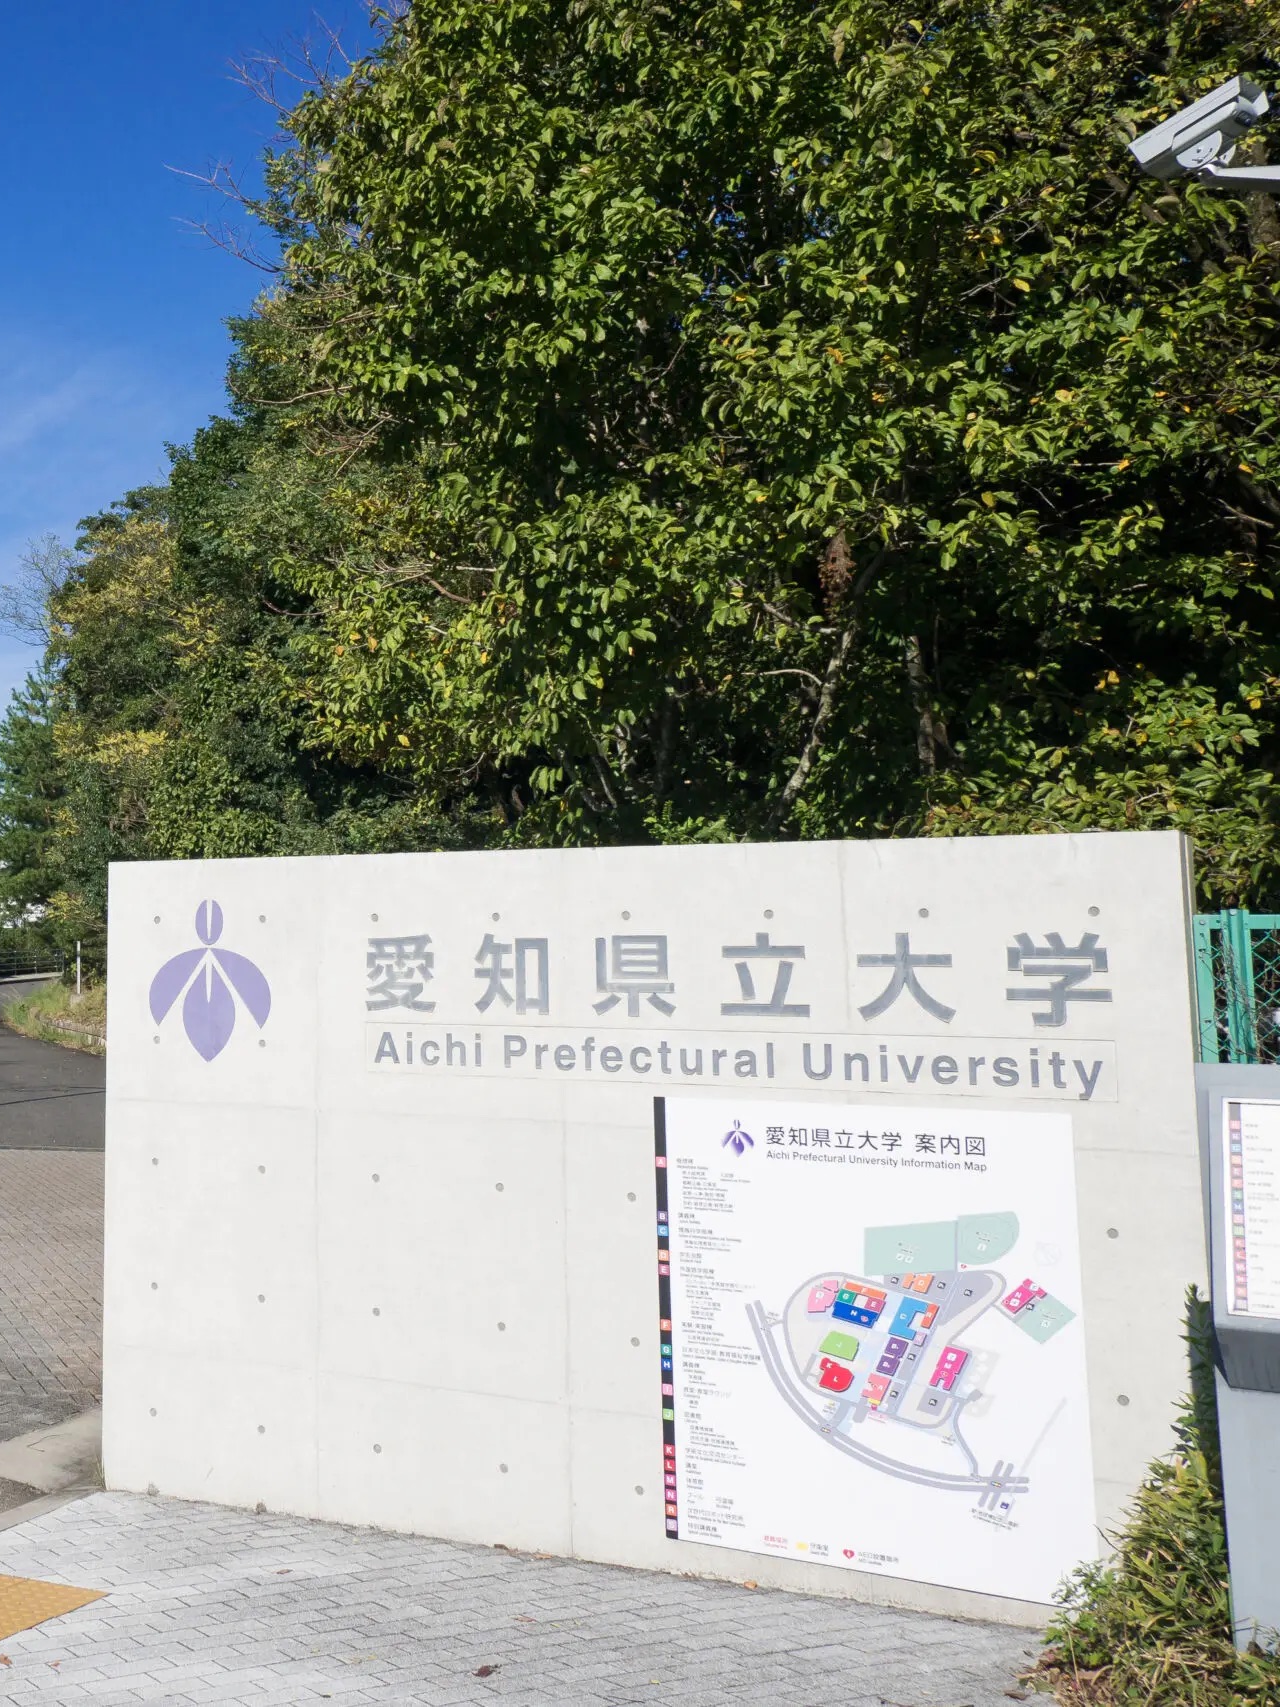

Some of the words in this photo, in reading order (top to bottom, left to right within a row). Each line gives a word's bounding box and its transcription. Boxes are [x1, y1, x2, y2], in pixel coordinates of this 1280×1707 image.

[366, 931, 1113, 1028] 愛知県立大学
[374, 1031, 483, 1067] Aichi
[503, 1034, 775, 1079] Prefectural
[802, 1042, 1104, 1101] University
[766, 1126, 902, 1151] 愛知県立大学
[915, 1133, 986, 1156] 案内図
[766, 1150, 790, 1160] Aichi
[793, 1151, 846, 1163] Prefectural
[849, 1155, 898, 1168] University
[901, 1157, 961, 1170] Information
[964, 1161, 988, 1173] Map
